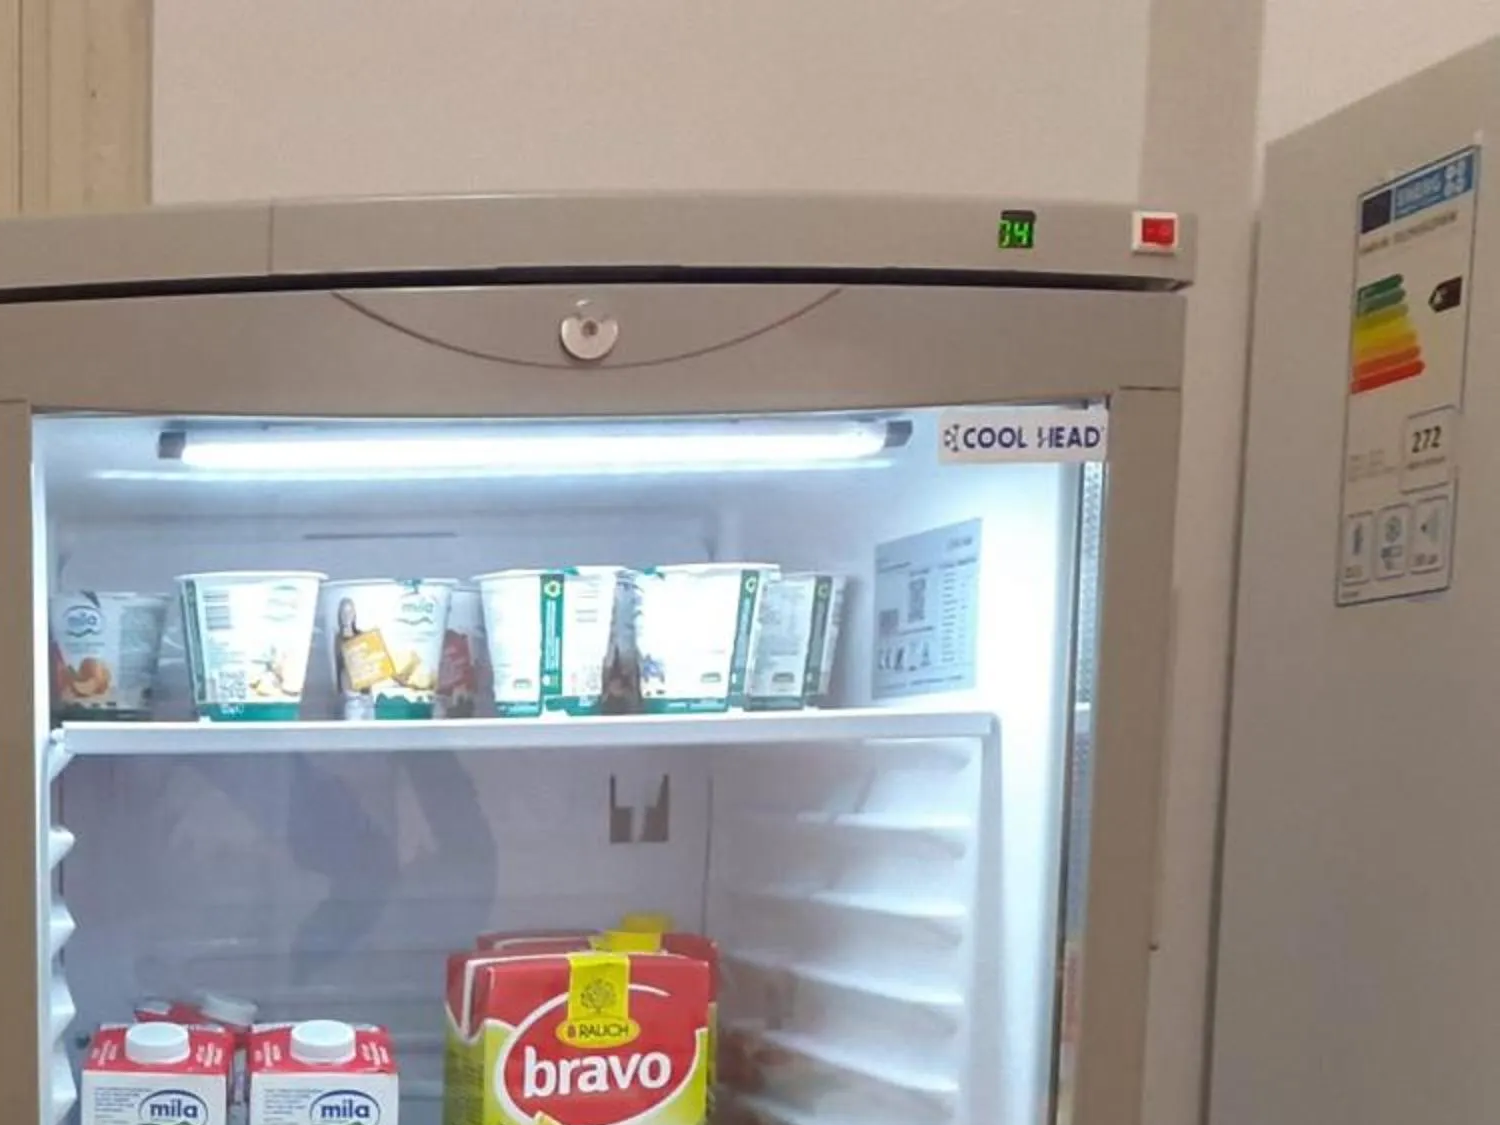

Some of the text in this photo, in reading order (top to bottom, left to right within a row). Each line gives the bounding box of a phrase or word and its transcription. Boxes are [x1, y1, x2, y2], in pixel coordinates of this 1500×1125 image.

[963, 426, 1101, 449] COOL HEAD
[579, 1023, 630, 1038] RAUCH
[524, 1045, 672, 1098] bravo
[150, 1098, 199, 1119] mila
[321, 1099, 370, 1119] mila
